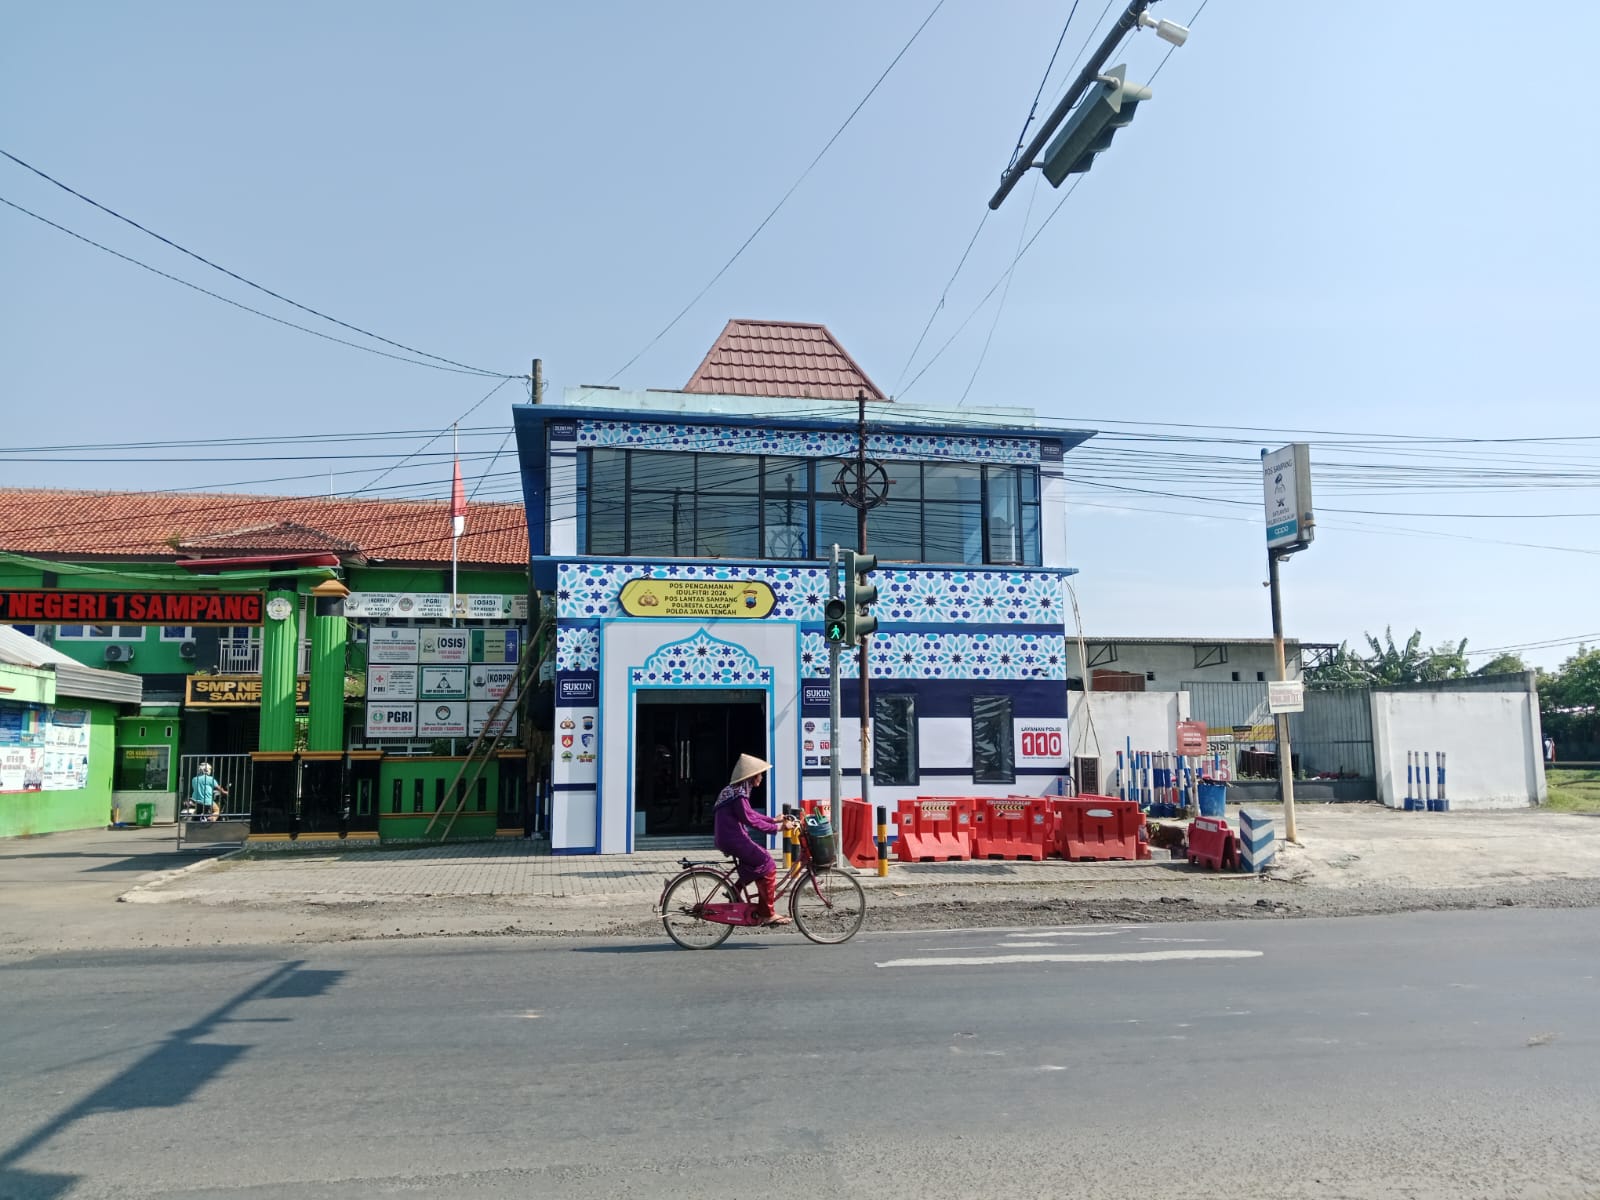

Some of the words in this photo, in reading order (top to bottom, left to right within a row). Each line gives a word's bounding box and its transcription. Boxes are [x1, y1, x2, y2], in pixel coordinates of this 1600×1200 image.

[8, 593, 107, 619] NEGERI
[114, 596, 126, 619] 1
[129, 595, 259, 620] SAMPANG
[437, 636, 466, 649] (OSIS)
[195, 681, 236, 693] SMP
[562, 683, 592, 691] SUKUN
[387, 711, 412, 723] PGRI
[1023, 735, 1060, 753] 110
